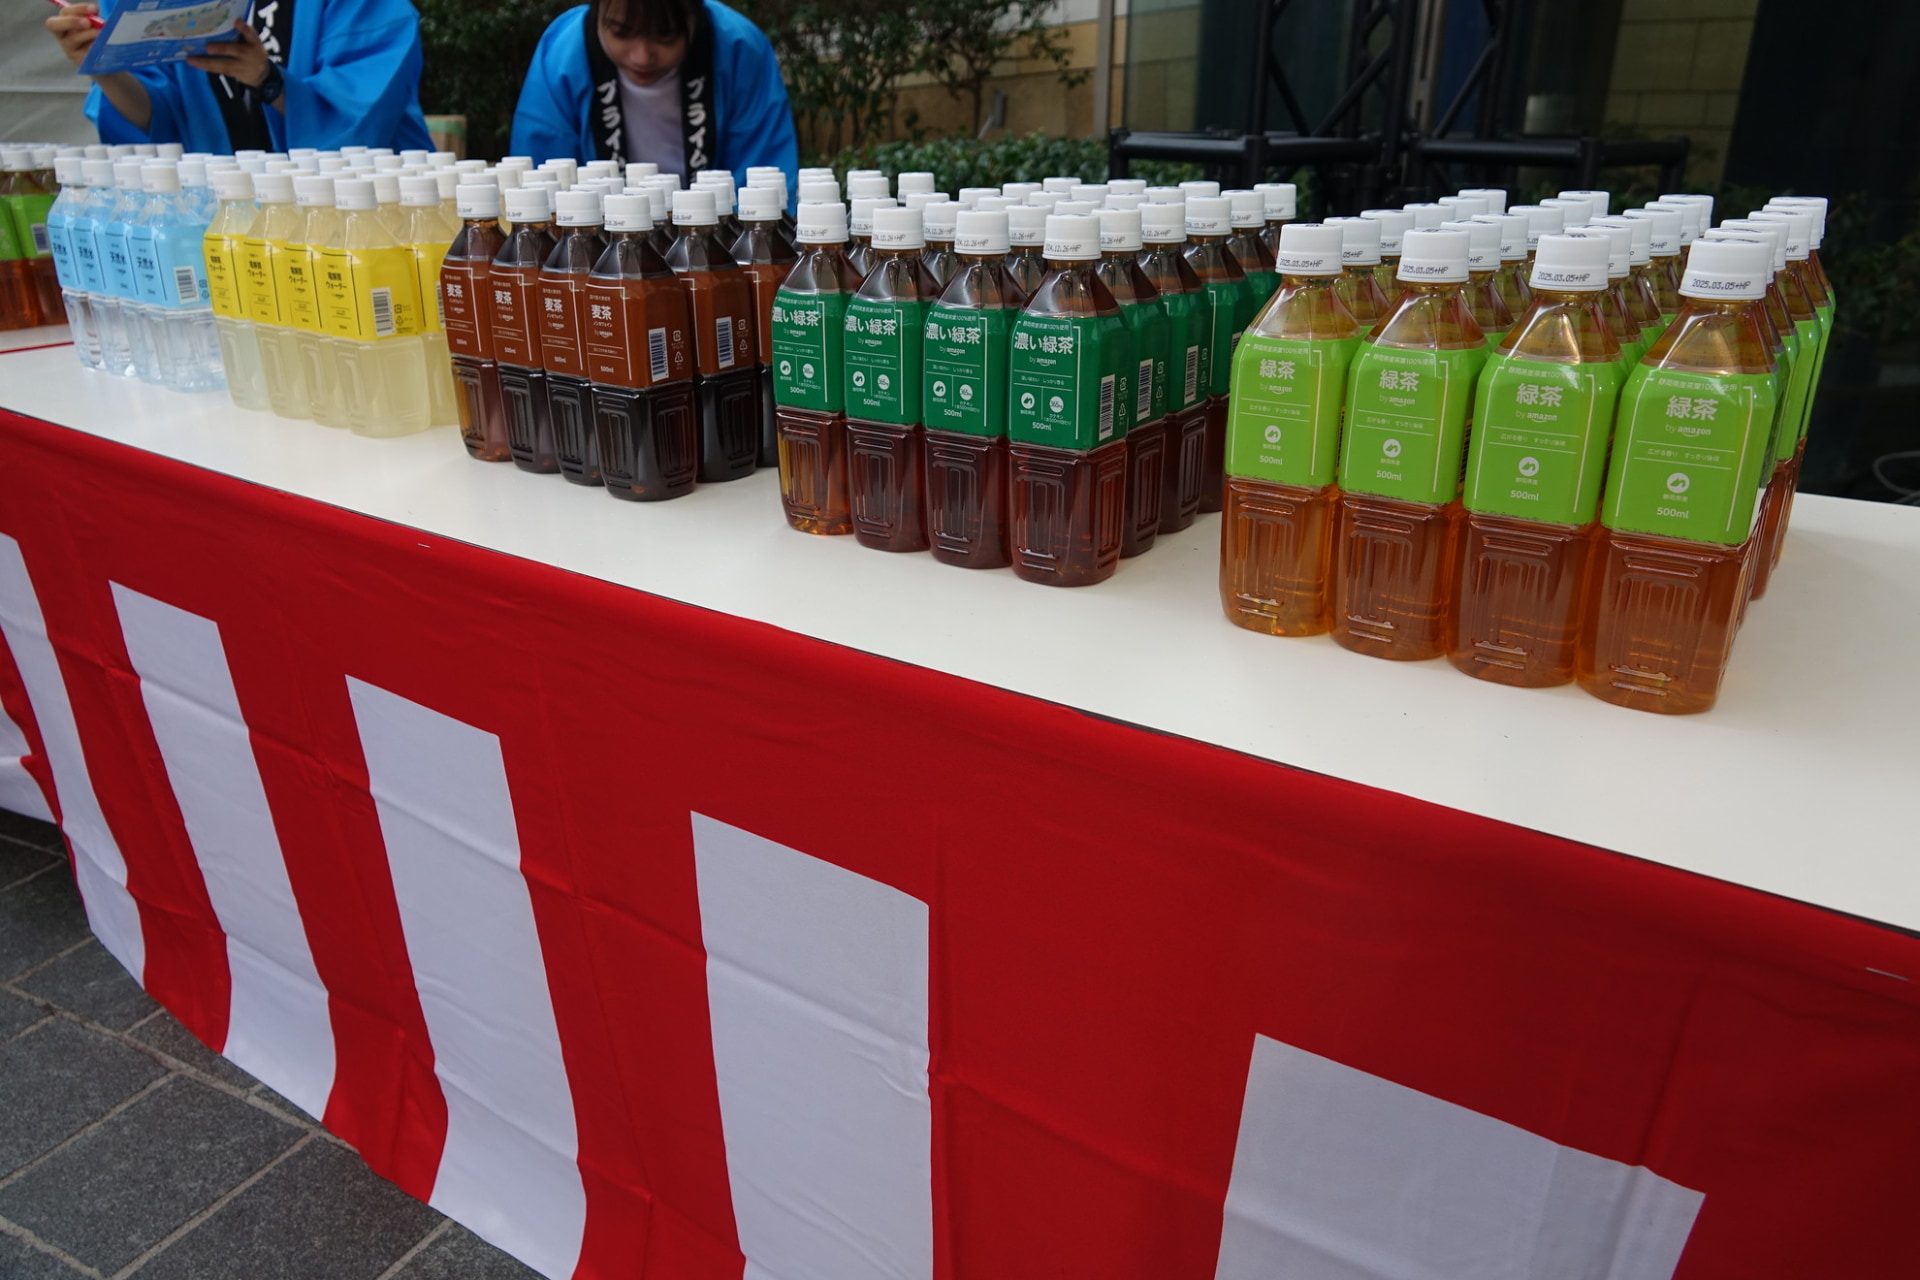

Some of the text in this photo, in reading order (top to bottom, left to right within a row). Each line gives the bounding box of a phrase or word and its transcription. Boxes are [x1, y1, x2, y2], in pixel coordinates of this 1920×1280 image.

[1280, 257, 1323, 268] 2025.03.05+HP
[1402, 264, 1449, 275] 2025.03.05+HP
[1538, 271, 1590, 282] 2025.03.05+HP
[1692, 278, 1750, 289] 2025.03.05+HP
[447, 283, 463, 297] 麦茶
[495, 290, 512, 304] 麦茶
[544, 298, 563, 312] 麦茶
[591, 305, 612, 320] 麦茶
[772, 307, 819, 326] 濃い緑茶
[845, 315, 896, 335] 濃い緑茶
[926, 323, 980, 344] 濃い緑茶
[865, 339, 882, 347] amazon
[1014, 332, 1073, 354] 濃い緑茶
[947, 347, 965, 356] amazon
[1037, 357, 1056, 366] amazon
[1260, 359, 1295, 380] 緑茶
[1379, 369, 1420, 392] 緑茶
[1260, 383, 1292, 395] by amazon
[1516, 383, 1564, 407] 緑茶
[864, 398, 880, 406] 500ml
[1379, 395, 1415, 407] by amazon
[944, 409, 962, 417] 500ml
[1666, 395, 1719, 421] 緑茶
[1515, 410, 1557, 423] by amazon
[1032, 422, 1051, 431] 500ml
[1665, 424, 1711, 437] by amazon
[1259, 455, 1283, 466] 500ml
[1376, 470, 1402, 481] 500ml
[1511, 489, 1539, 501] 500ml
[1656, 507, 1689, 519] 500ml
